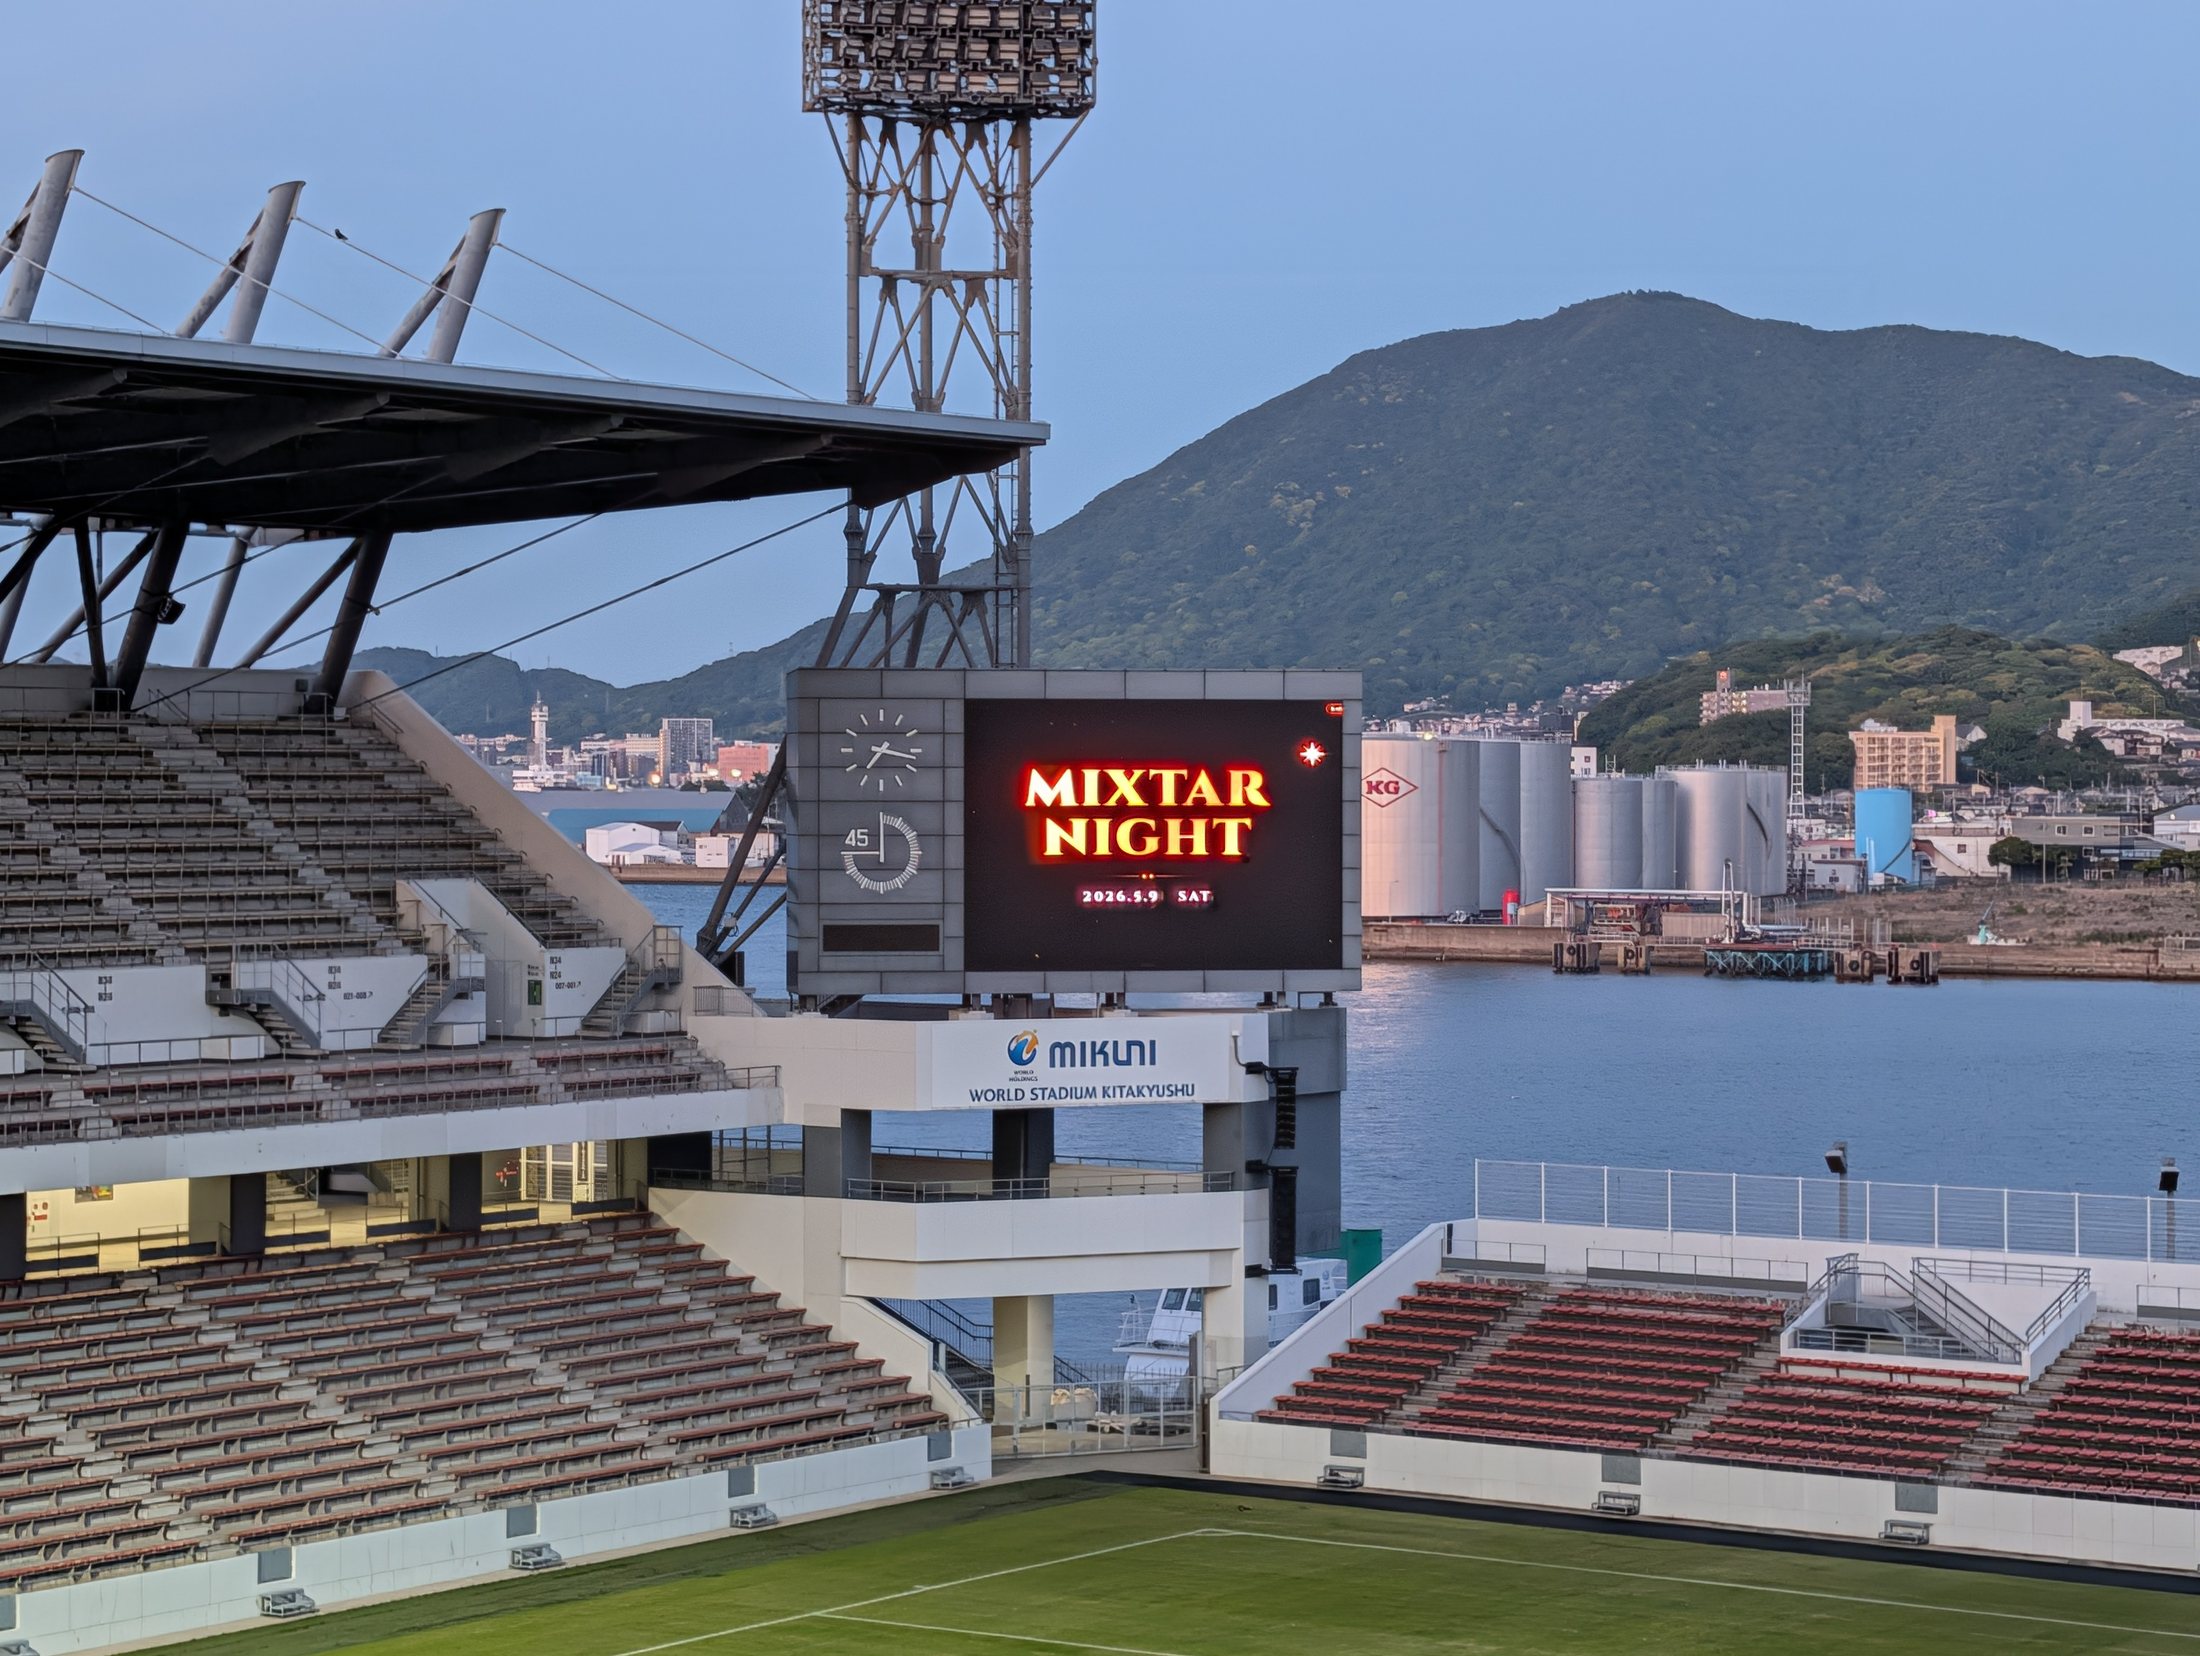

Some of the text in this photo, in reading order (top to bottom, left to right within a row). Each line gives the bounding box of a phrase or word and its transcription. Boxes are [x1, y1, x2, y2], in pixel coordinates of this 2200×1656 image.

[1025, 768, 1271, 807] MIXTAR
[1365, 780, 1400, 795] KG
[844, 828, 868, 847] 45
[1044, 817, 1252, 857] NIGHT
[1082, 889, 1211, 903] 2026.5.9 SAT
[969, 1083, 1196, 1102] WORLD STADIUM KITAKYUSHU
